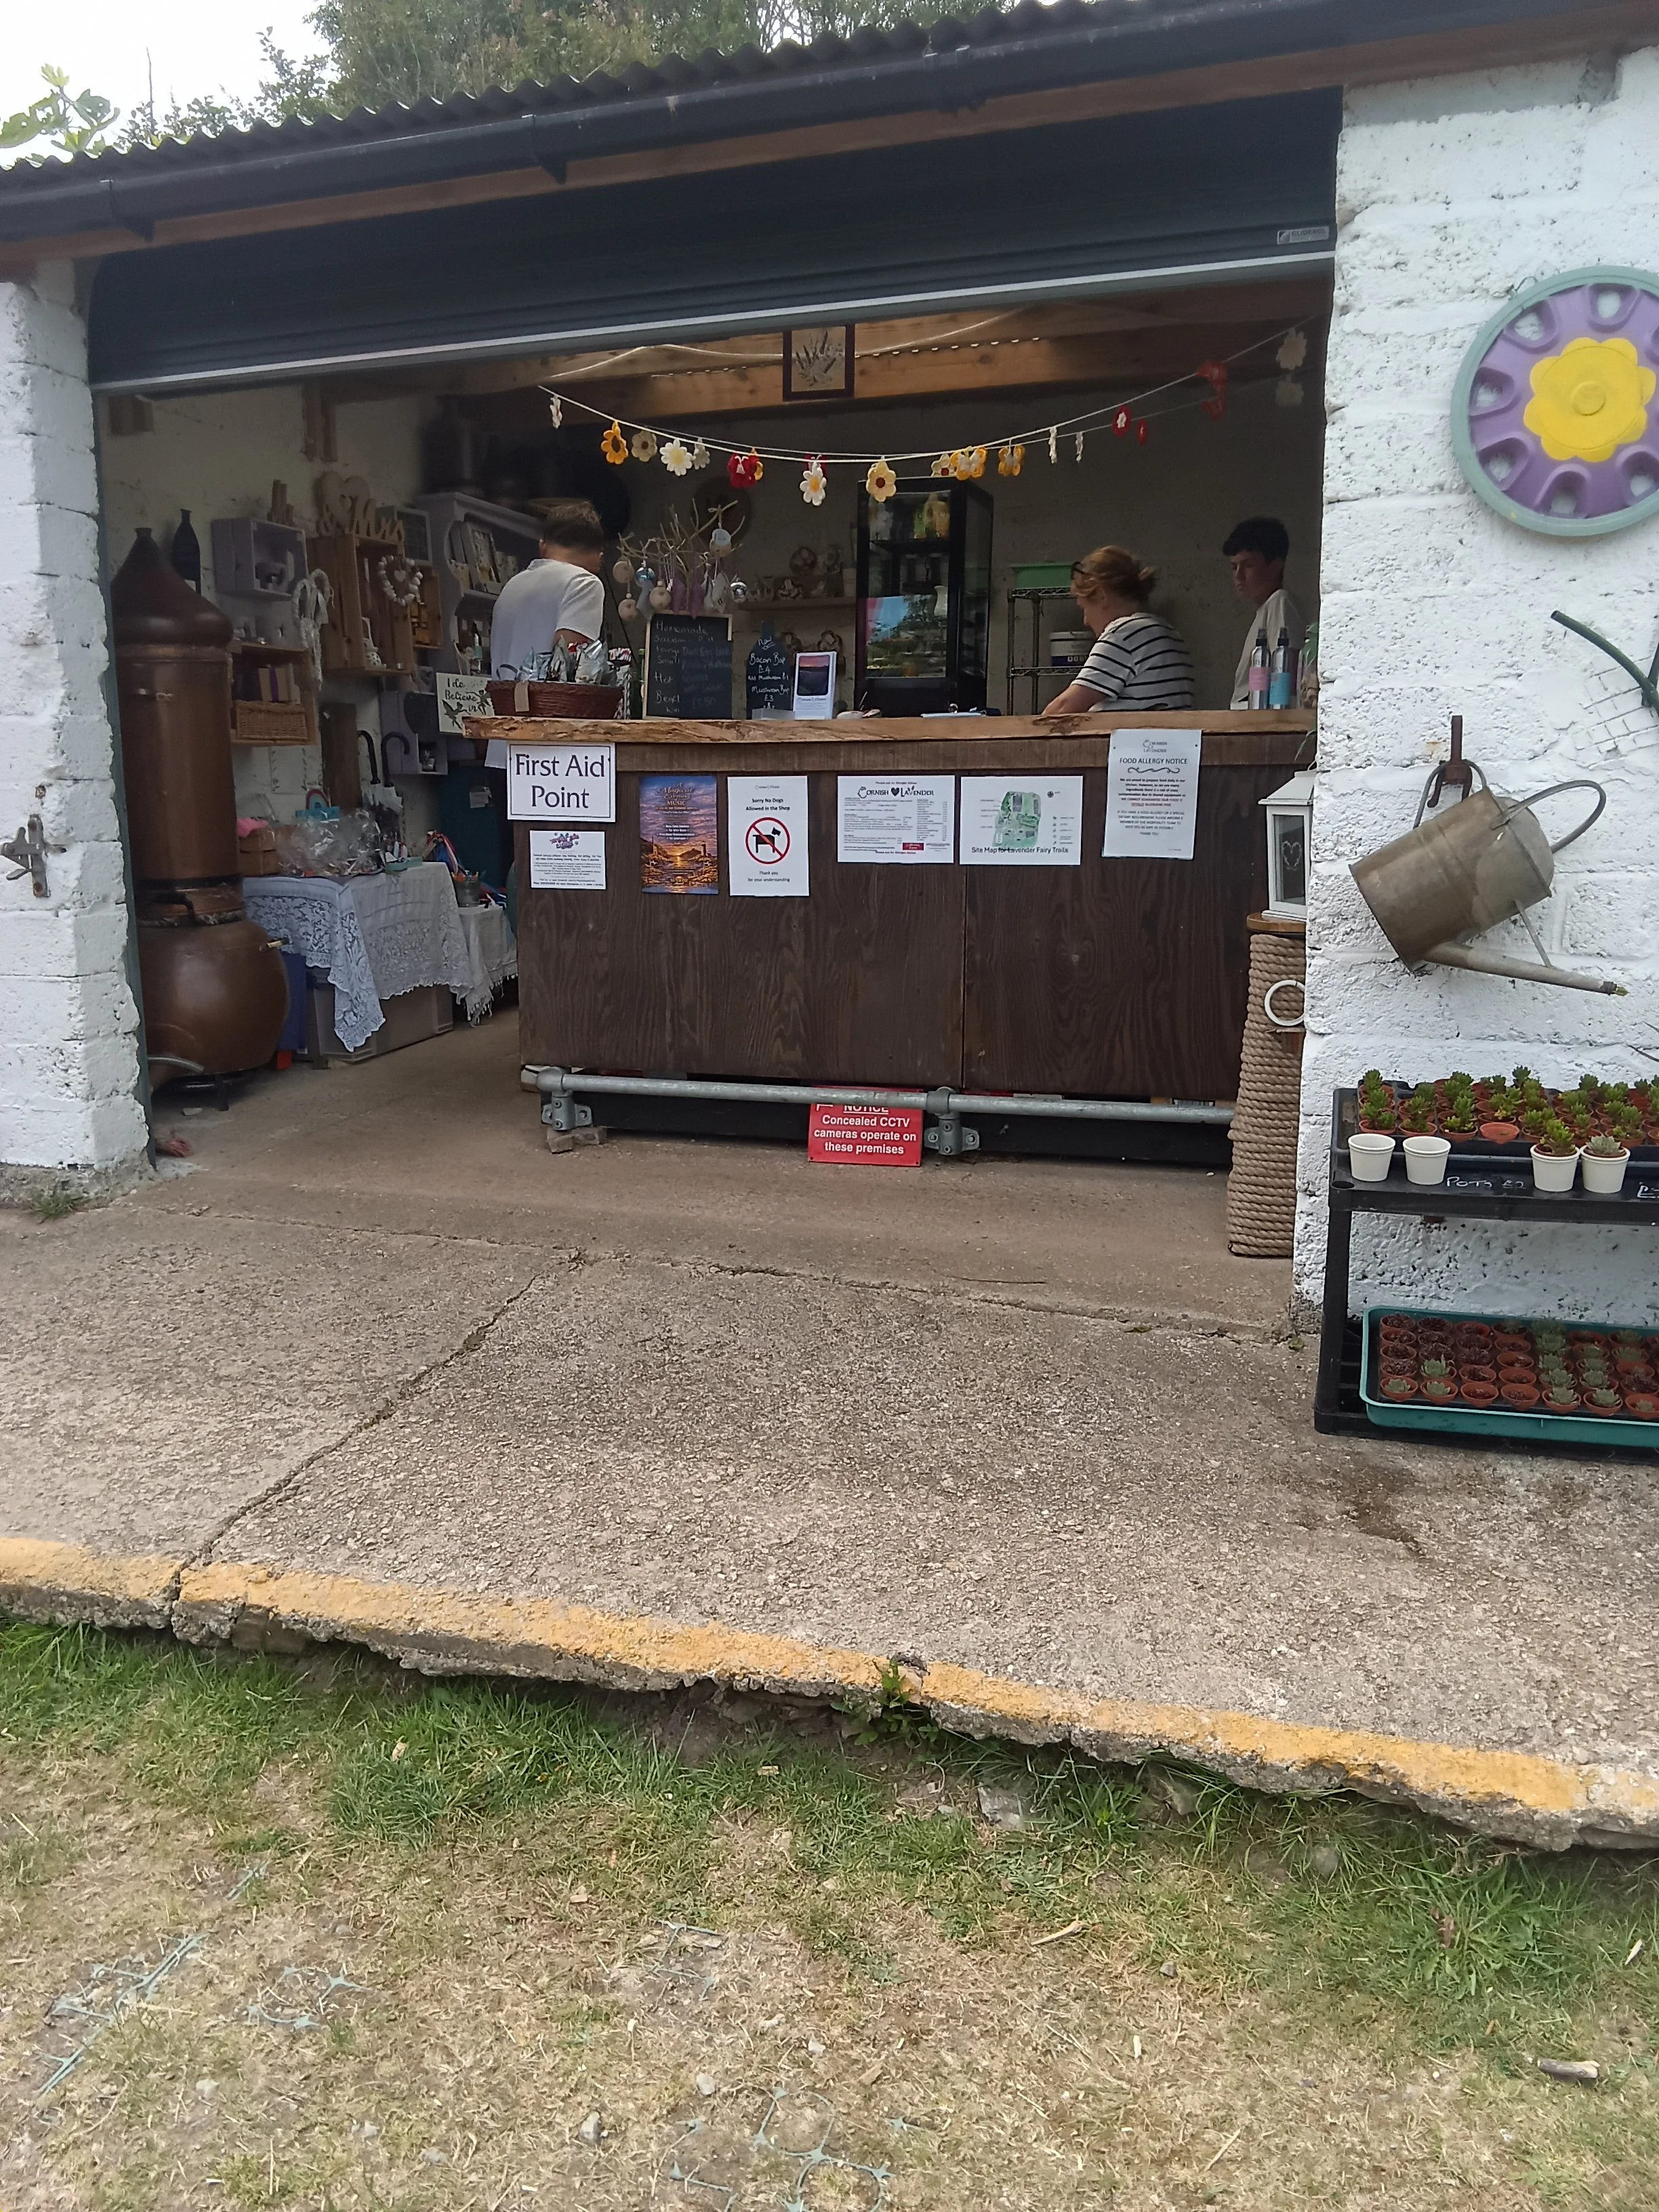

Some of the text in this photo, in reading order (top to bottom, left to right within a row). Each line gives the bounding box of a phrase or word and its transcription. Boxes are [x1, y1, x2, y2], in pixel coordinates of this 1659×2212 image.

[656, 620, 708, 635] Homemade
[750, 652, 785, 665] Bacon Bap
[759, 665, 770, 674] £4
[447, 678, 466, 687] I do
[445, 689, 478, 701] Believe
[764, 693, 774, 702] £3
[516, 754, 605, 777] First Aid
[531, 785, 590, 808] Point
[857, 785, 934, 798] CORNISH LAVENDER
[822, 1114, 910, 1127] Concealed CCTV
[814, 1130, 857, 1139] cameras
[860, 1132, 900, 1142] operate
[825, 1141, 904, 1155] these premises
